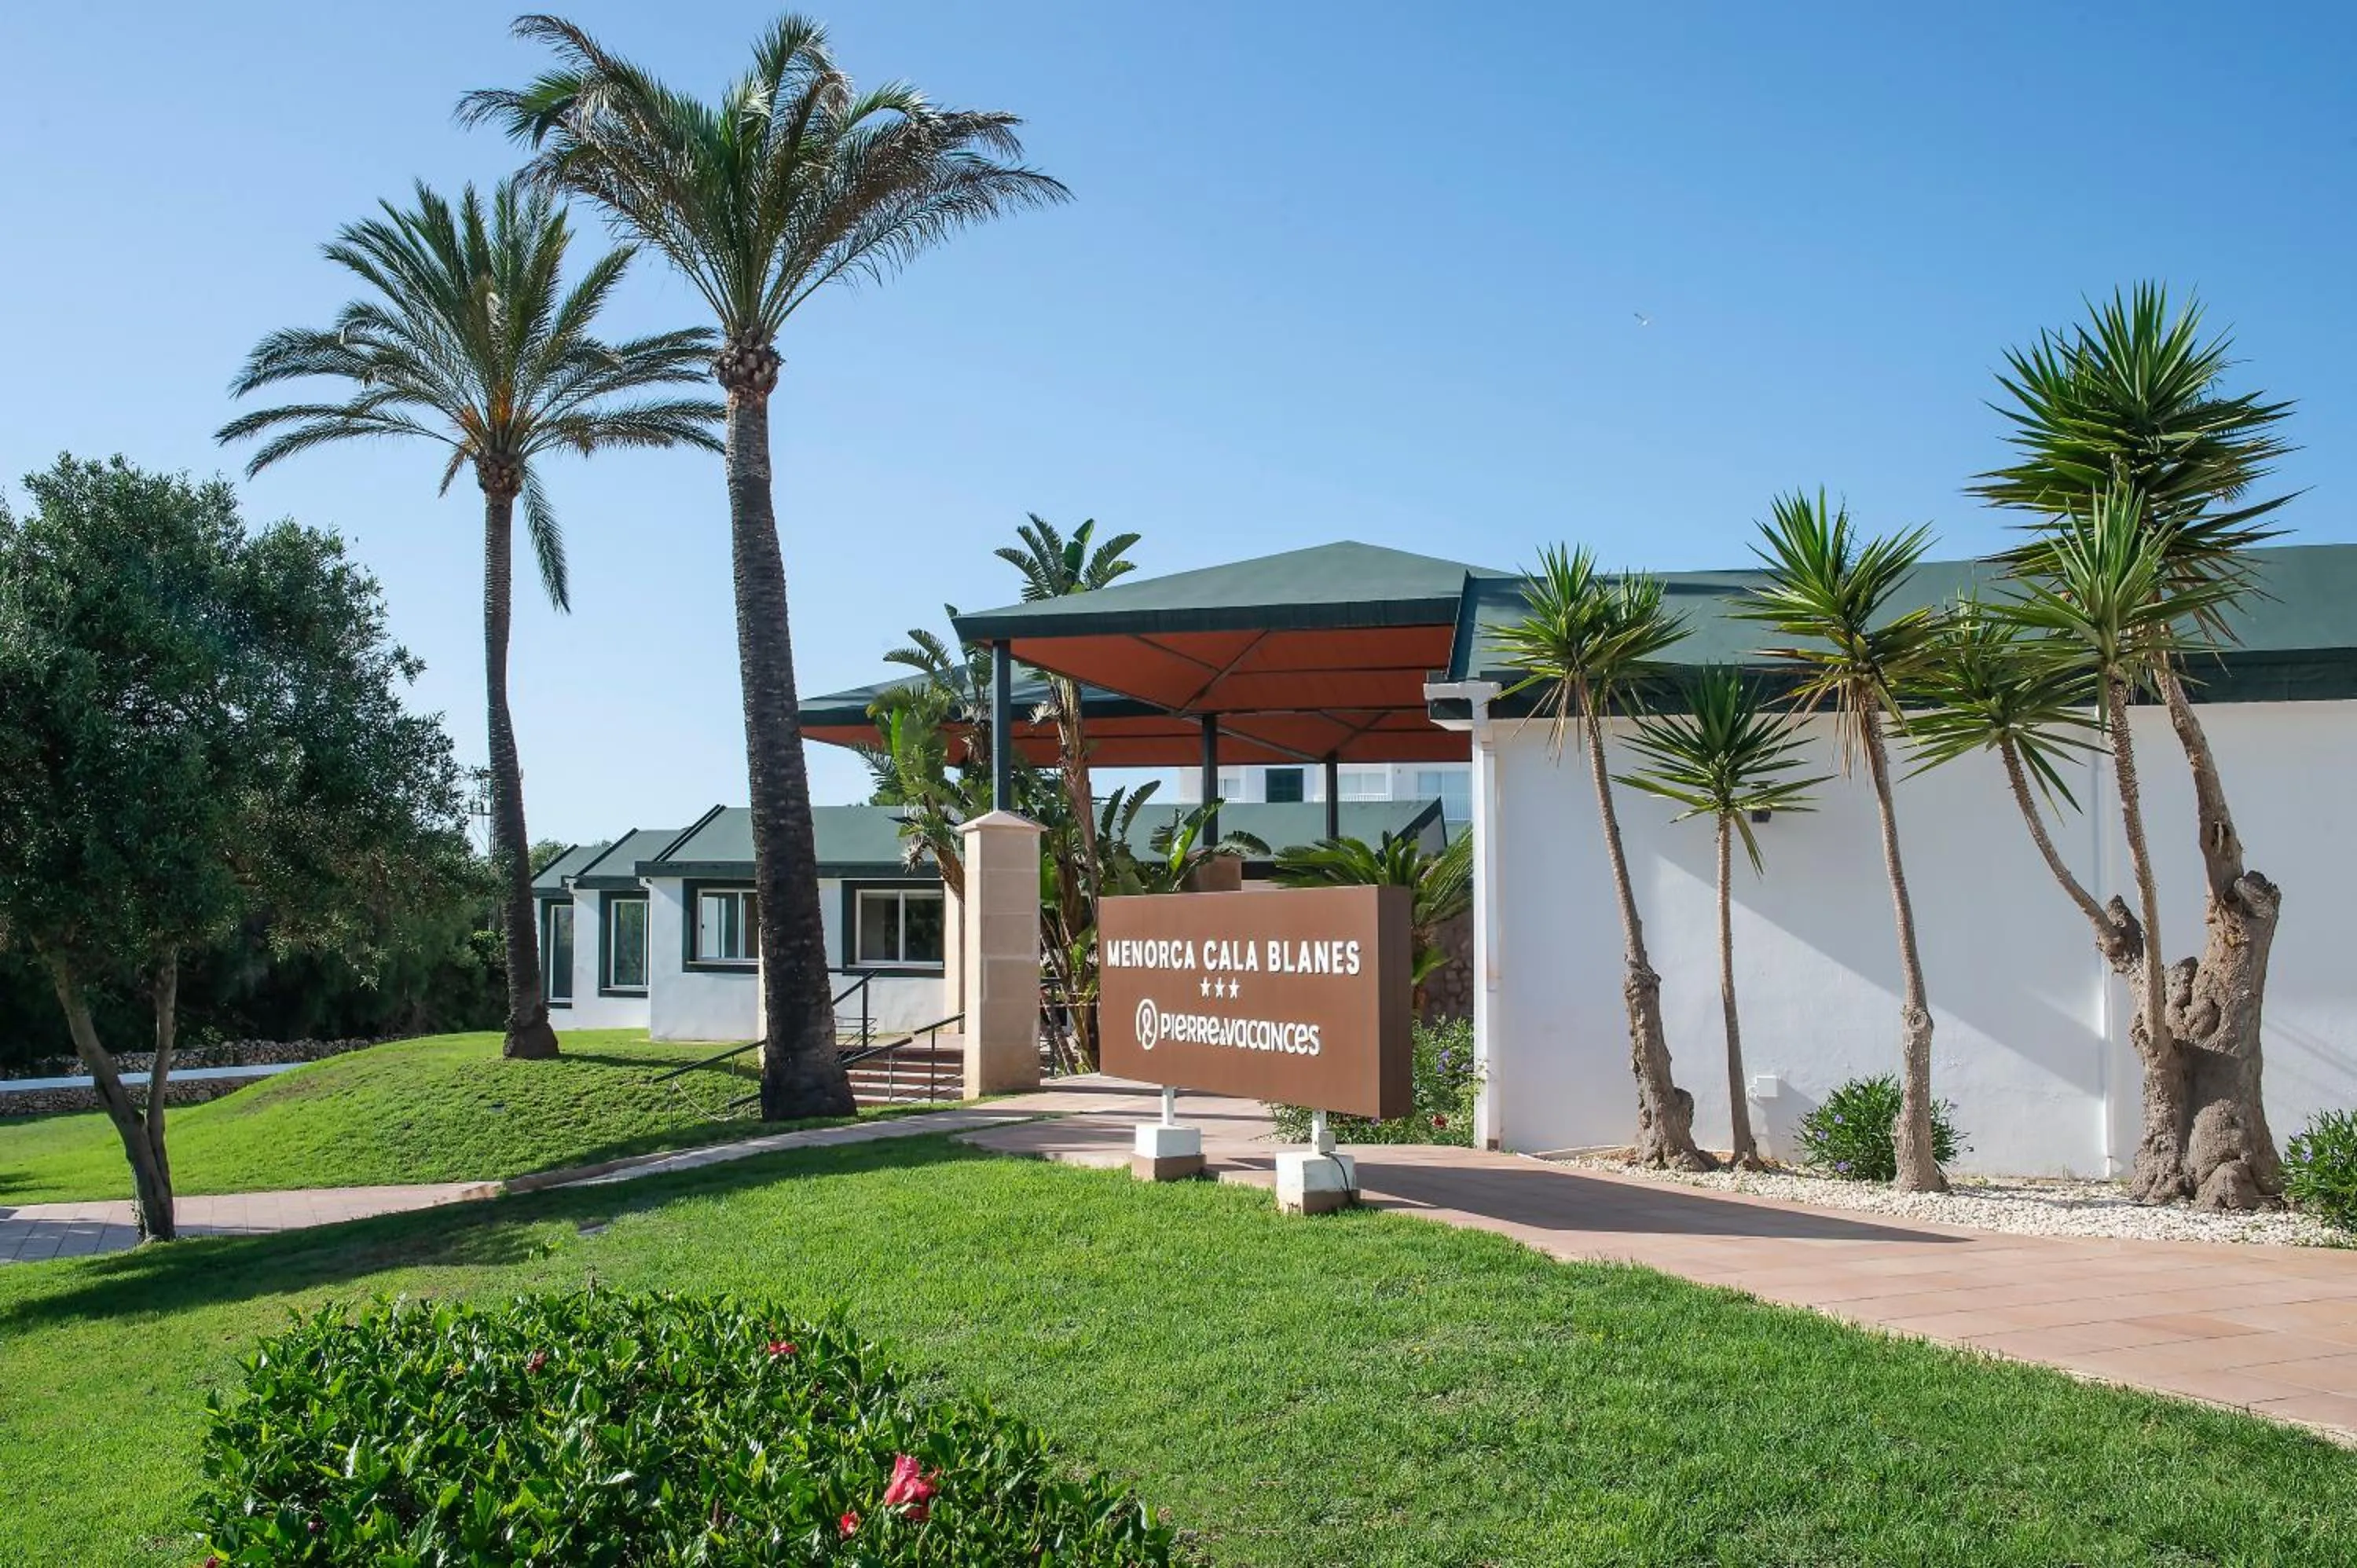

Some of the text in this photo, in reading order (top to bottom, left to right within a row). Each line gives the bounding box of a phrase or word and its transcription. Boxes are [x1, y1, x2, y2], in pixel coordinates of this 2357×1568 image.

[1107, 940, 1361, 975] MENORCA CALA BLANES
